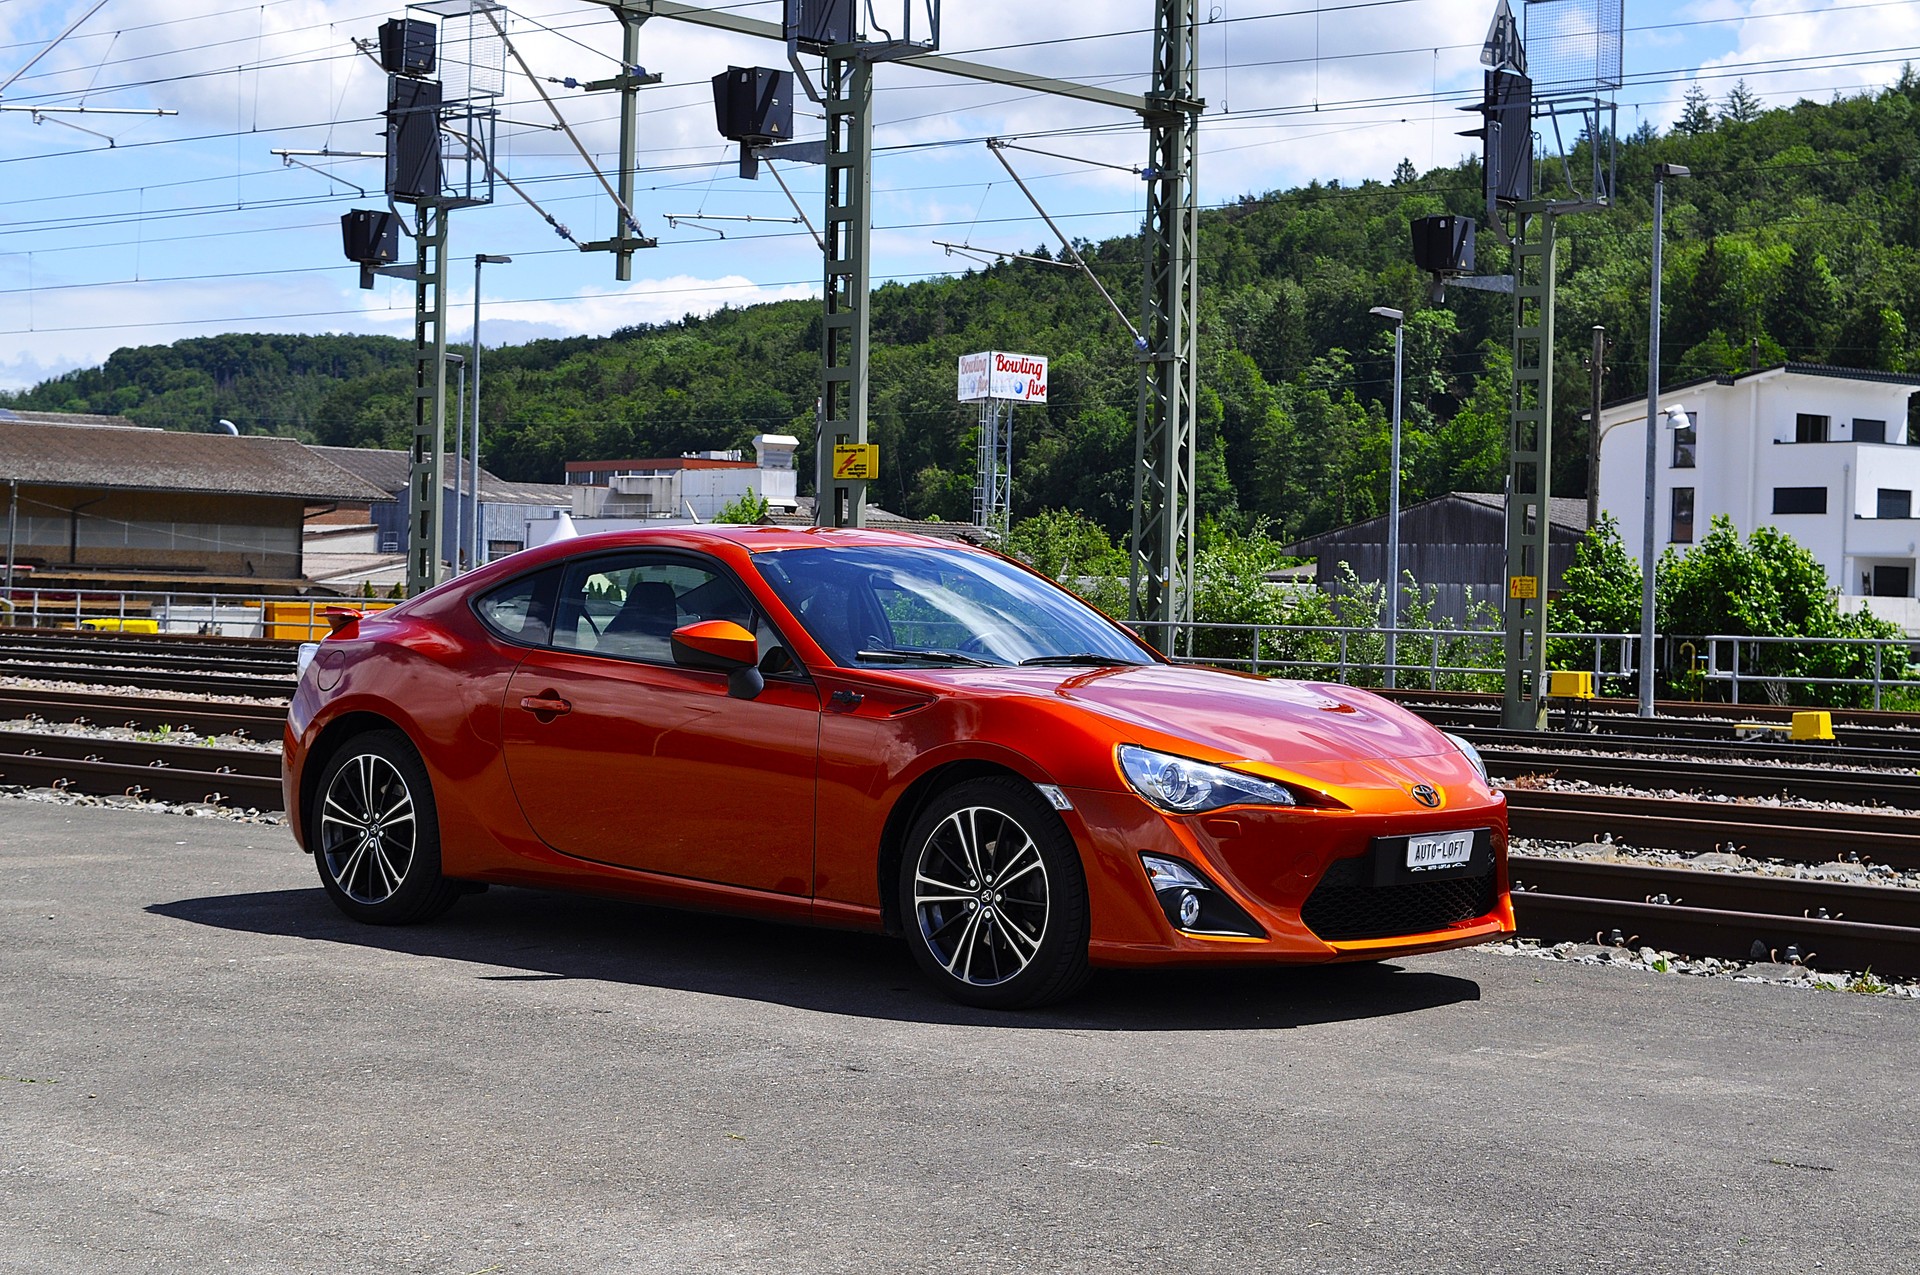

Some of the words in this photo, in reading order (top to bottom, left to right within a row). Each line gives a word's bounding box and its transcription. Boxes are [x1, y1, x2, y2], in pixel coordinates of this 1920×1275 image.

[961, 356, 987, 376] Bowling
[995, 354, 1043, 380] Bowling
[976, 376, 988, 397] five
[1025, 379, 1046, 399] five
[1414, 839, 1466, 861] AUTO-LOFT
